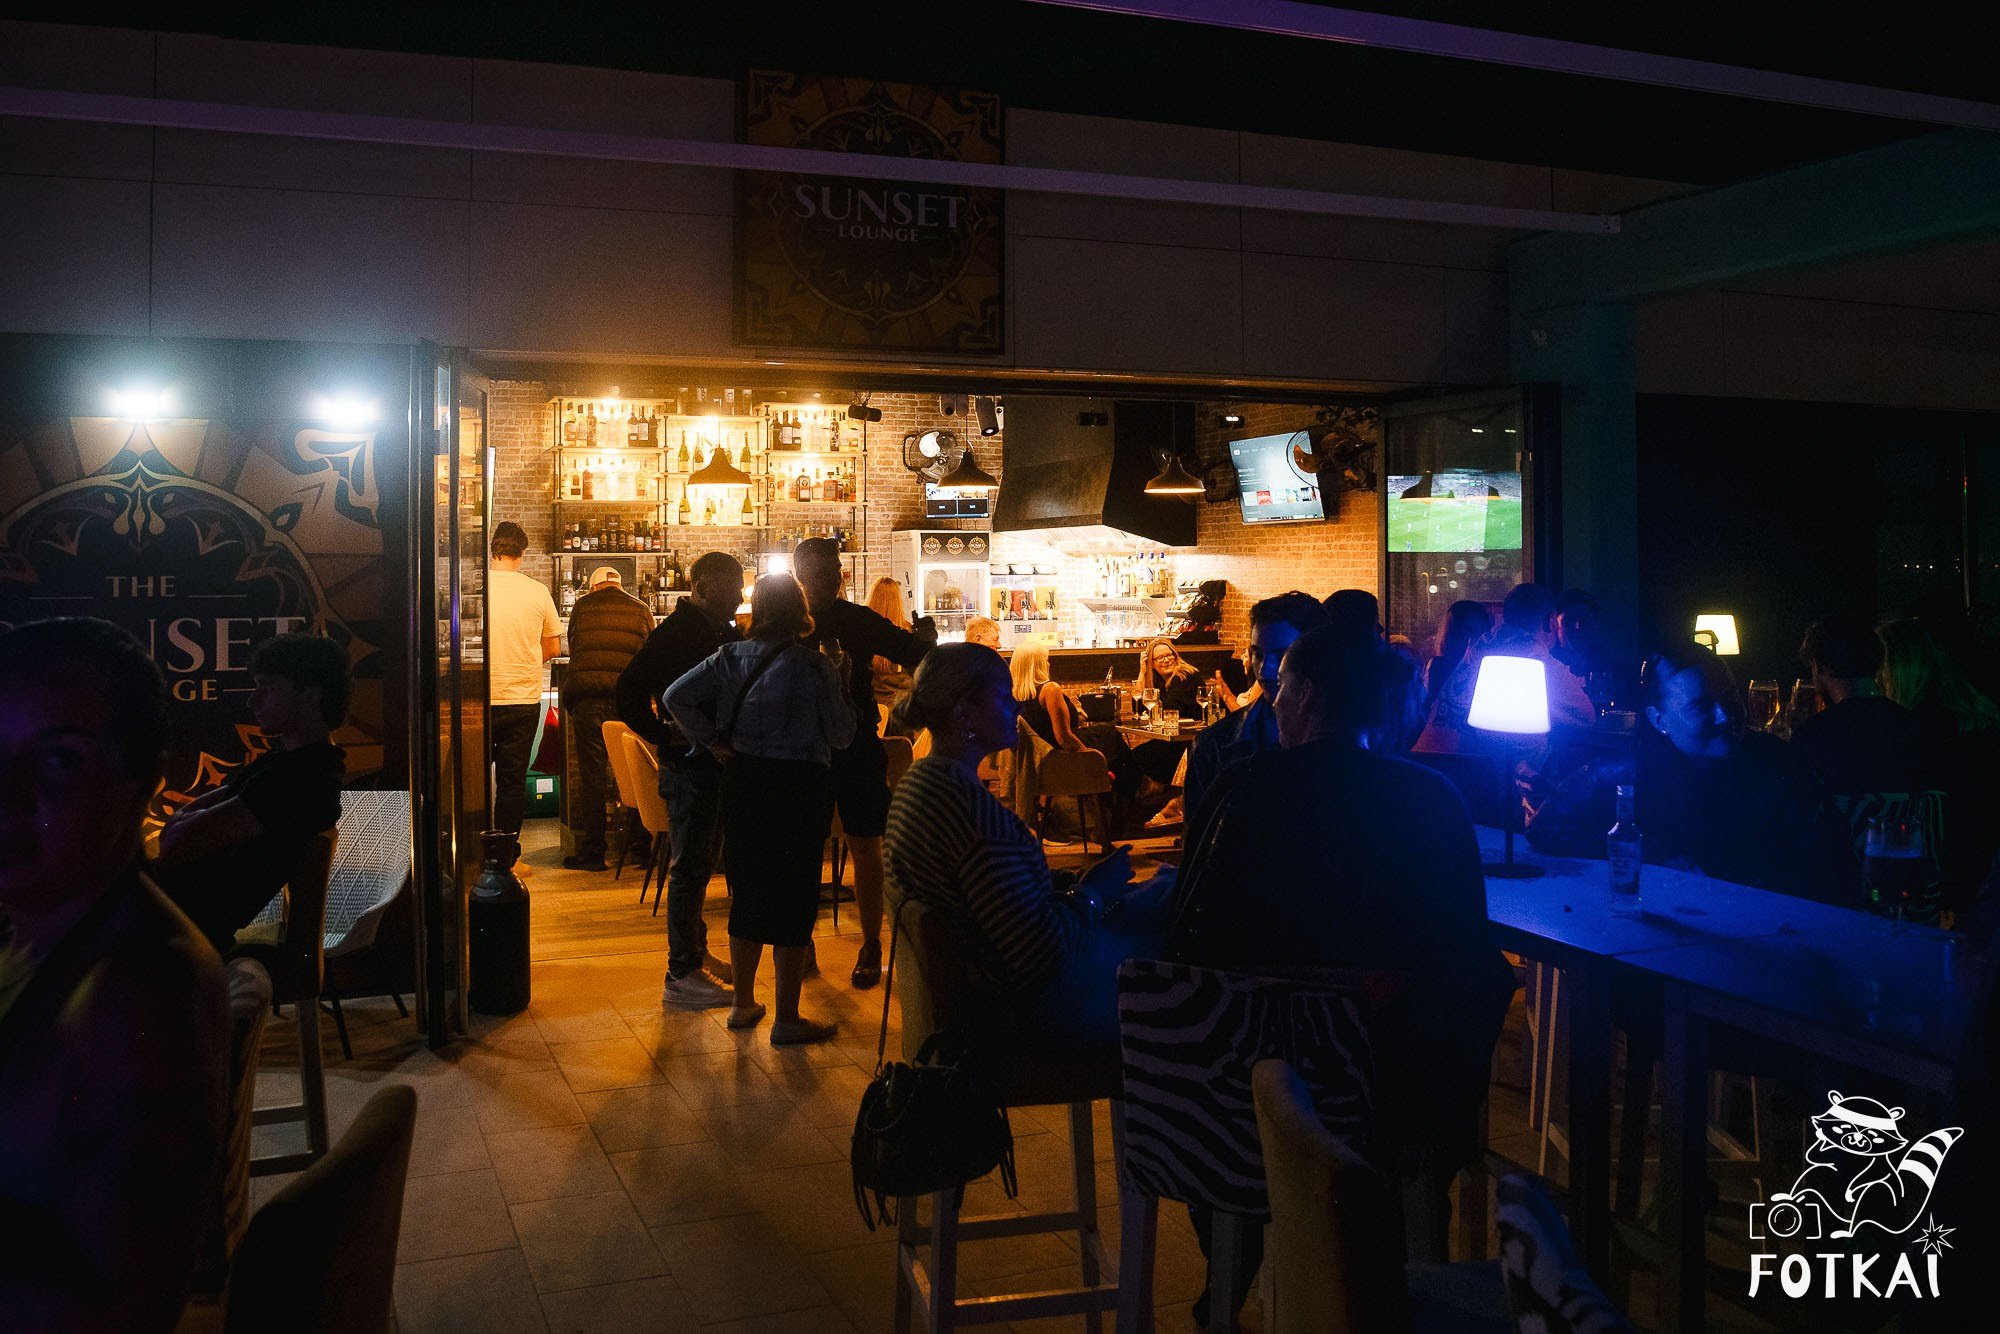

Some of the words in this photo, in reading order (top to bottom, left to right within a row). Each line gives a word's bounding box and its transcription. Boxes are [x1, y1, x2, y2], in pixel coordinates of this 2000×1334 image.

[793, 185, 965, 228] SUNSET
[839, 224, 920, 243] LOUNGE
[105, 575, 177, 598] THE
